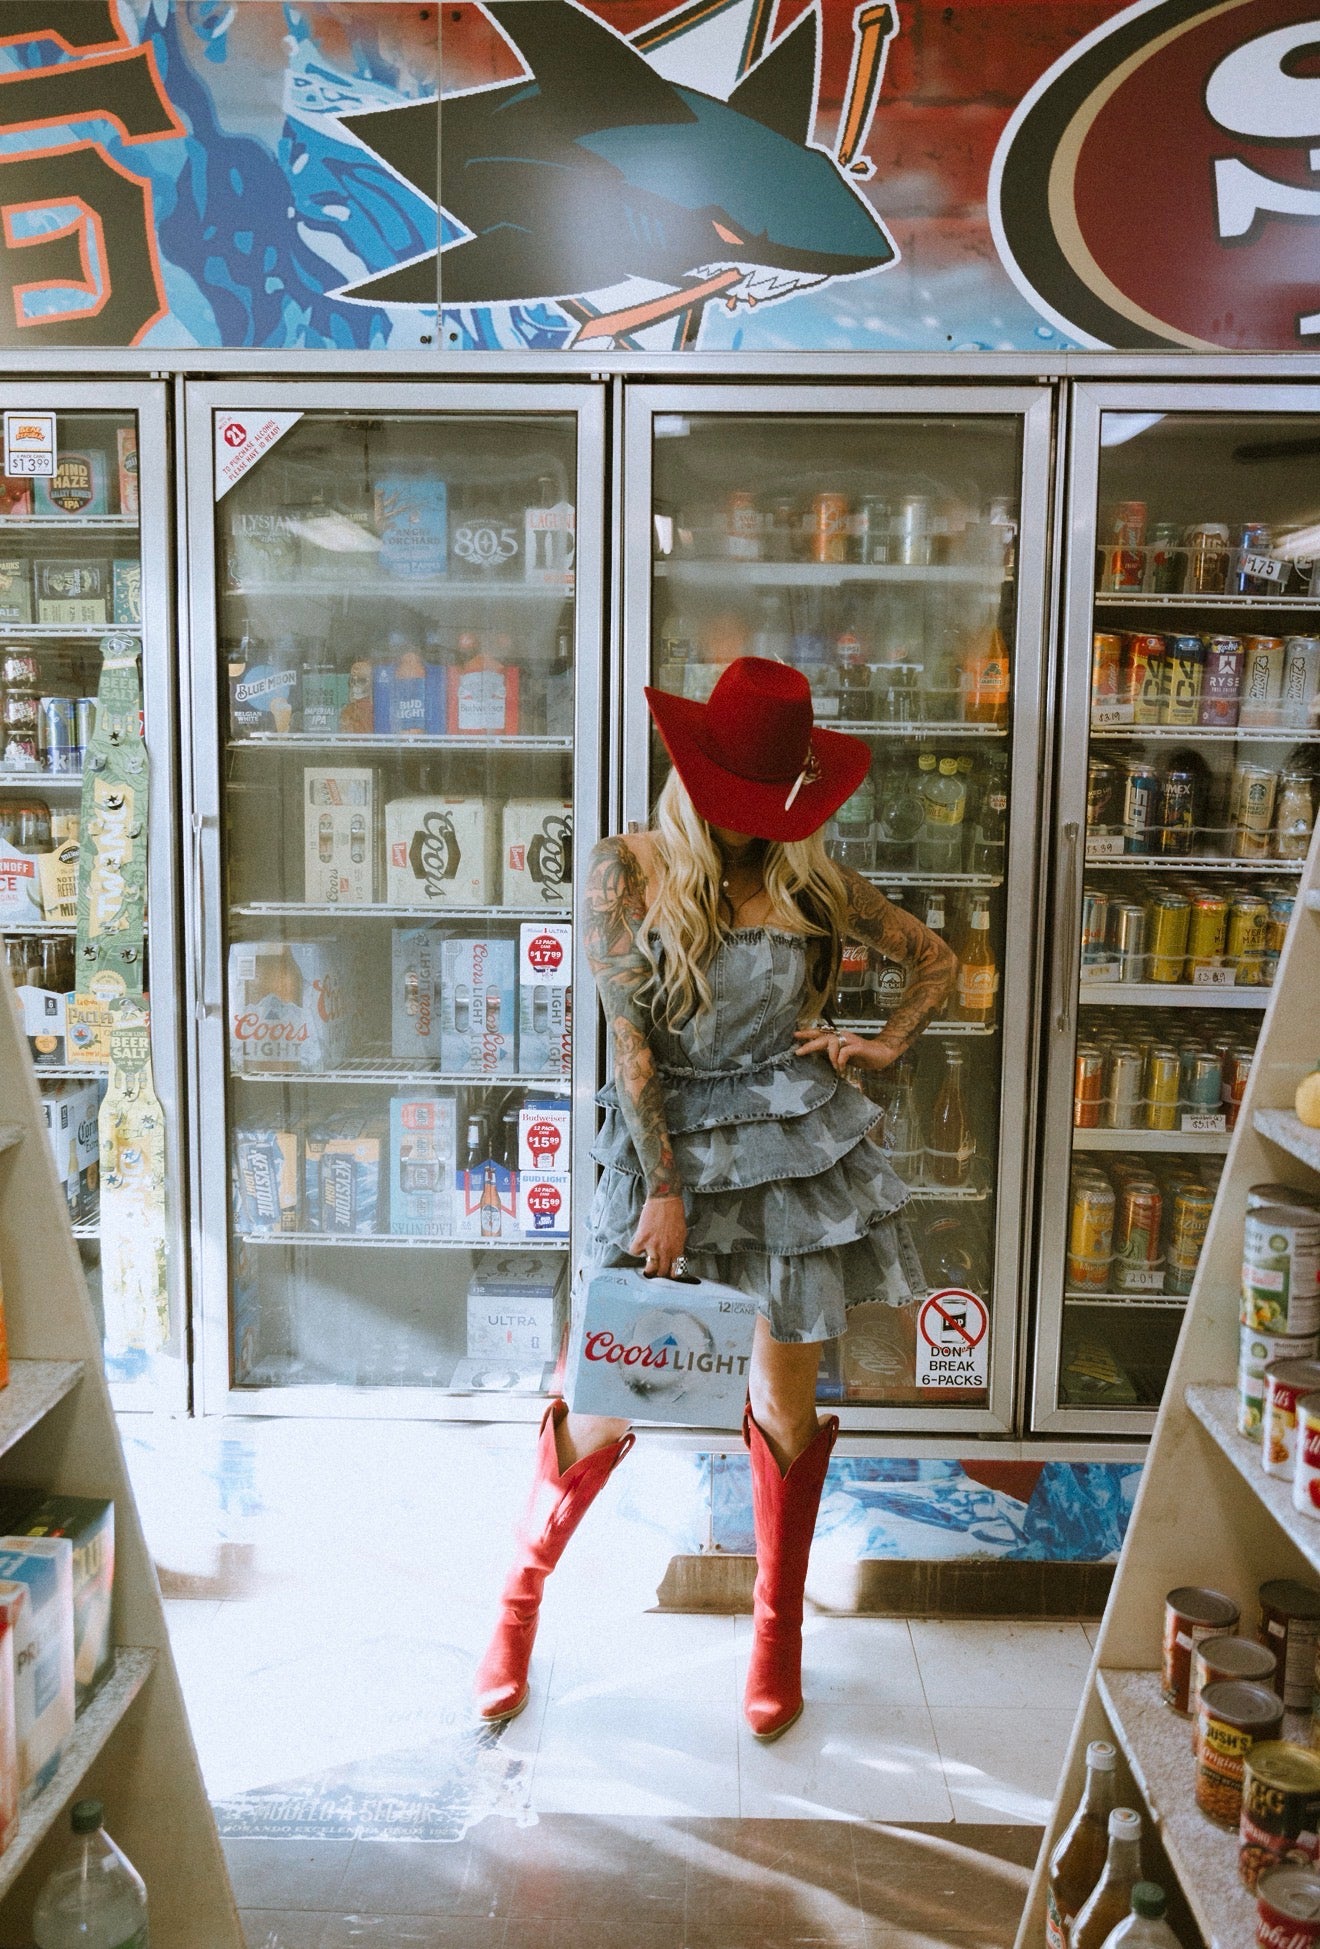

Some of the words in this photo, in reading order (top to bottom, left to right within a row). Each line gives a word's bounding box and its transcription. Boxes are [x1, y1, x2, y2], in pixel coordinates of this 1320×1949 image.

[226, 425, 246, 446] 21
[229, 441, 254, 466] PURCHASE
[254, 419, 276, 442] ALCOHOL
[228, 462, 247, 481] PLEASE
[246, 448, 260, 464] HAVE
[264, 425, 281, 443] READY
[57, 463, 88, 476] MIND
[53, 476, 89, 488] HAZE
[63, 501, 80, 510] IPA
[454, 528, 519, 557] 805
[236, 679, 266, 701] BLUE
[1209, 677, 1240, 687] RYSE
[400, 700, 422, 709] BUD
[311, 715, 327, 725] IPA
[398, 709, 425, 719] IGHT
[424, 810, 454, 900] Coors
[541, 814, 573, 903] Coors
[420, 952, 431, 993] LIGHT
[472, 943, 489, 985] Coors
[415, 993, 431, 1037] Coors
[472, 987, 483, 1025] LIGHT
[551, 986, 562, 1026] LIGHT
[234, 1012, 310, 1042] Coors
[111, 1036, 148, 1048] BEER
[242, 1042, 303, 1057] LIGHT
[112, 1047, 148, 1059] SALT
[522, 1113, 567, 1121] Budweiser
[243, 1168, 257, 1198] LIGHT
[247, 1149, 276, 1219] KEYSTONE
[325, 1177, 337, 1208] LIGHT
[331, 1159, 352, 1228] KEYSTONE
[718, 1301, 732, 1313] 12
[733, 1307, 756, 1316] CANS
[487, 1315, 538, 1327] ULTRA
[945, 1318, 964, 1327] PP
[584, 1331, 670, 1369] Coors
[673, 1350, 749, 1376] LIGHT
[930, 1346, 975, 1358] DON'T
[929, 1361, 976, 1372] BREAK
[921, 1375, 983, 1386] 6-PACKS
